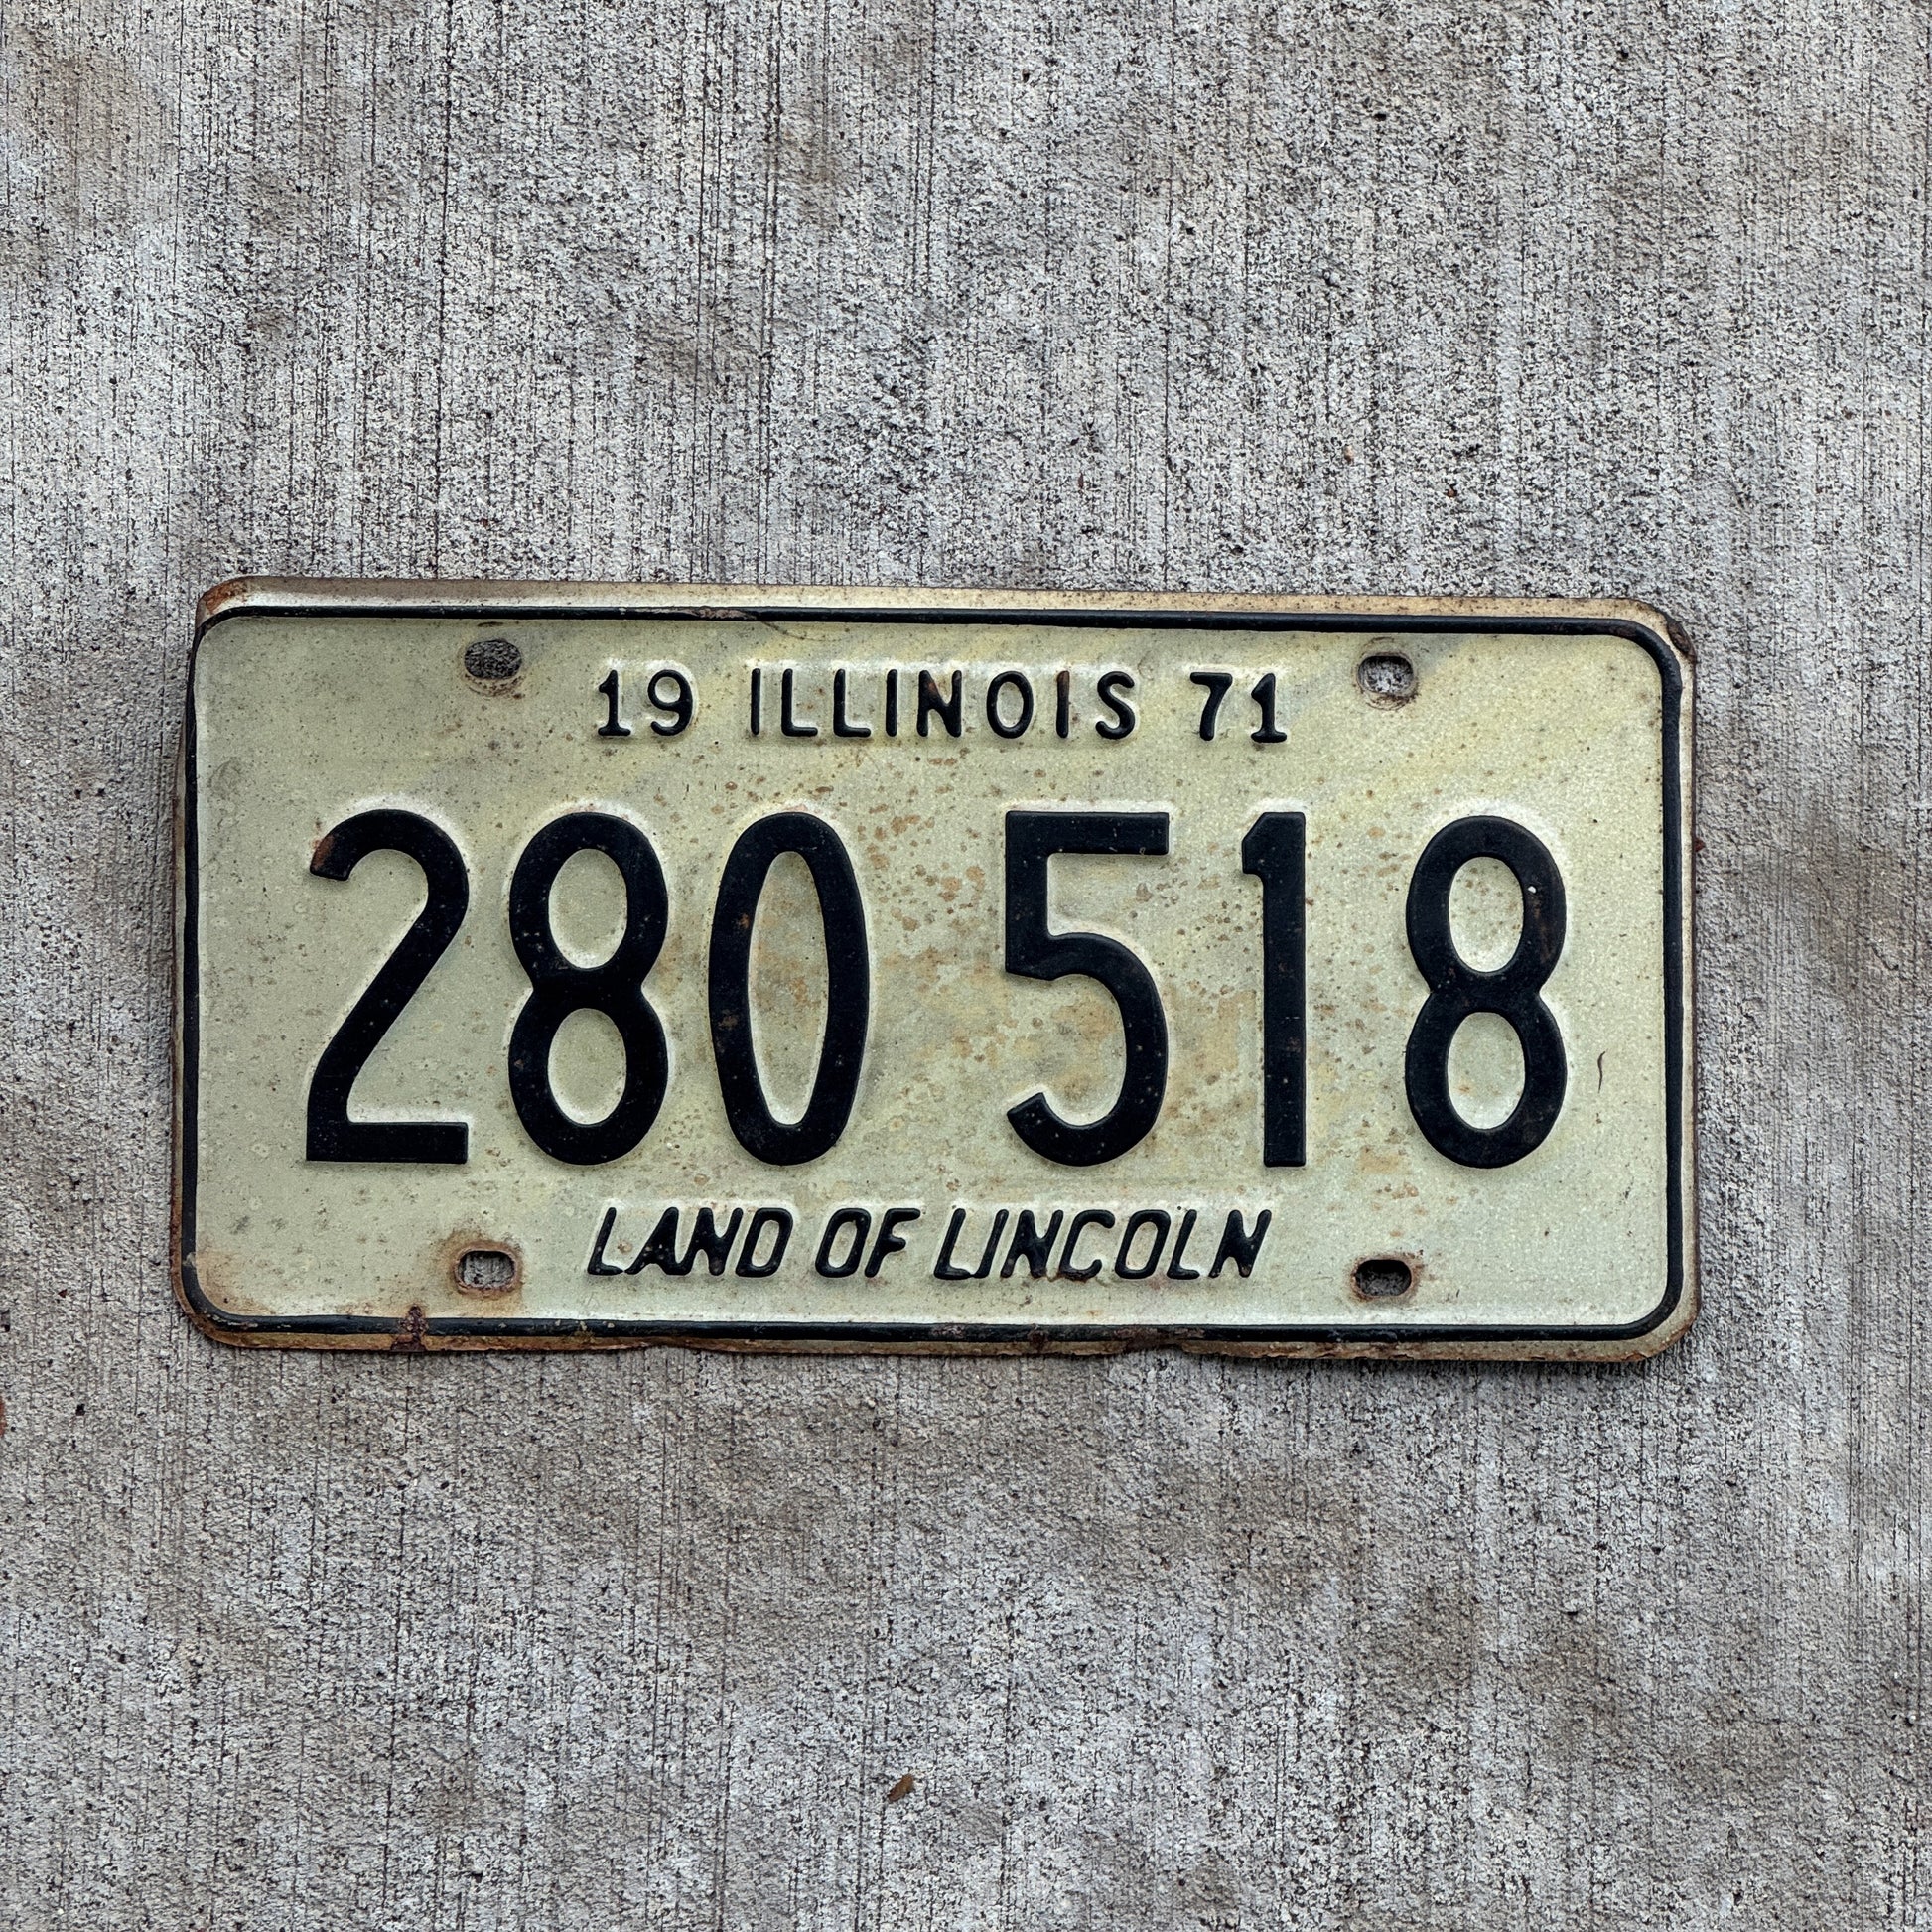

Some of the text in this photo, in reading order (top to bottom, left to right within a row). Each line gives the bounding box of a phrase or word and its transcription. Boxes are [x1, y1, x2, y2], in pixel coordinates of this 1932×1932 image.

[597, 667, 1288, 744] 19 ILLINOIS 71
[305, 808, 1569, 1171] 280 518
[586, 1206, 1273, 1282] LAND OF LINCOLN
